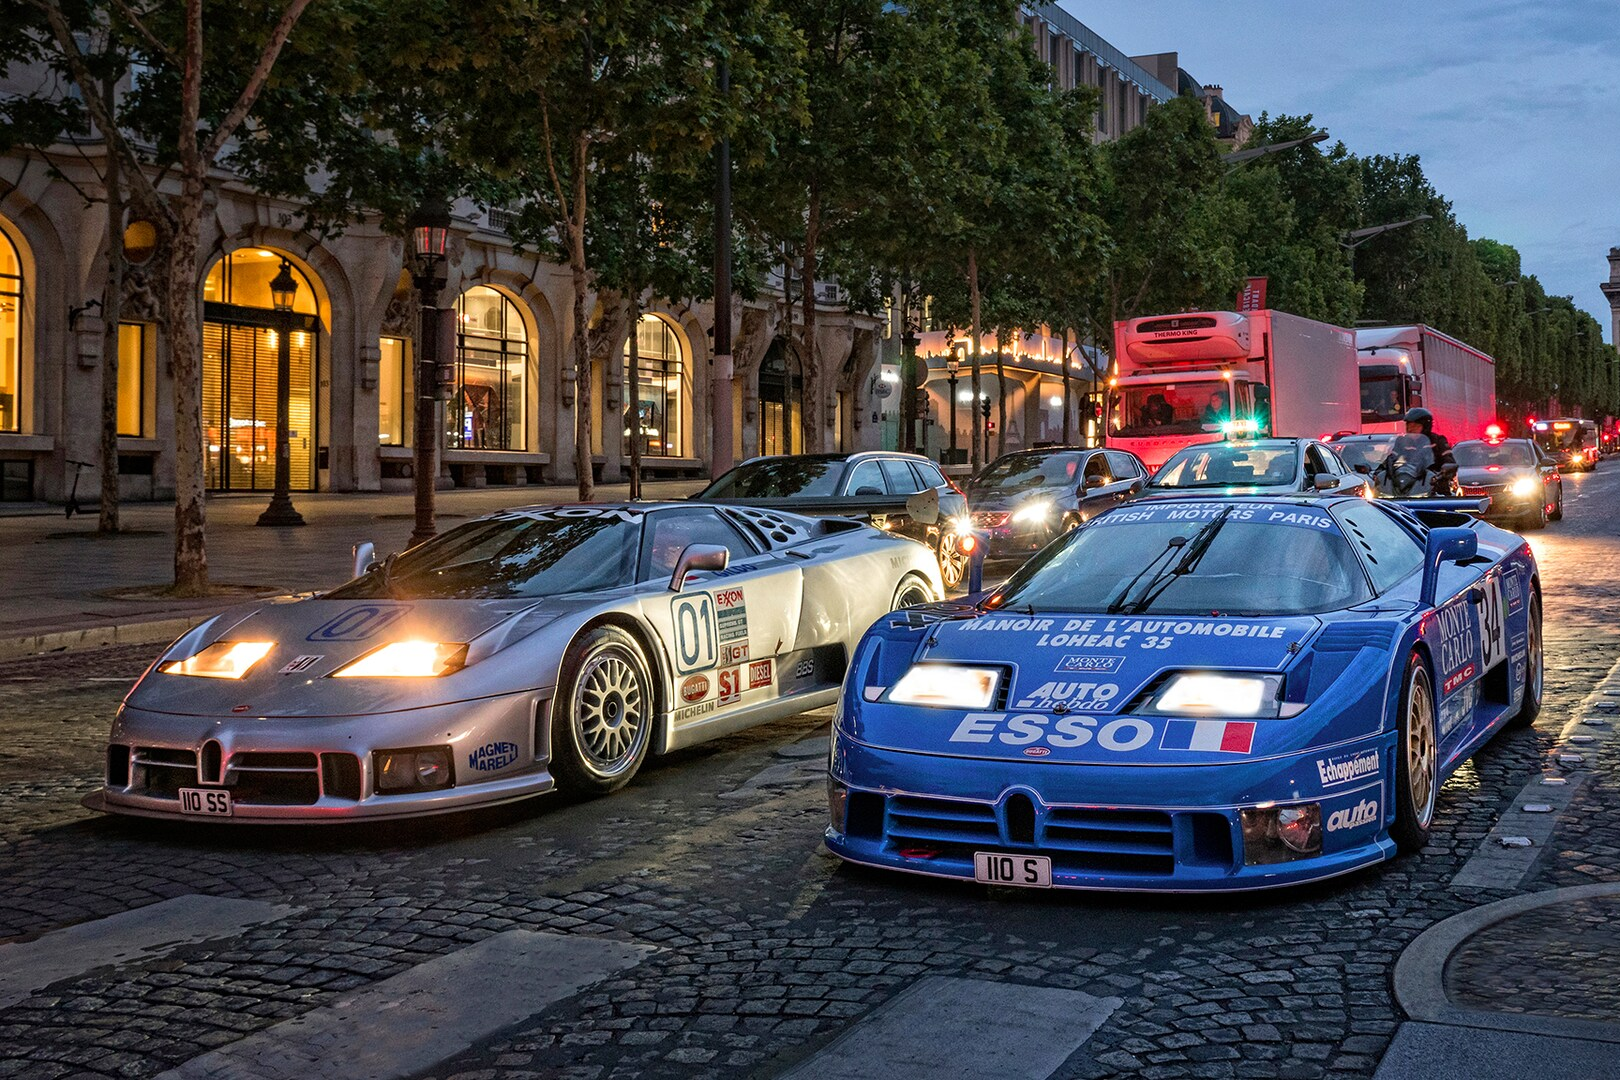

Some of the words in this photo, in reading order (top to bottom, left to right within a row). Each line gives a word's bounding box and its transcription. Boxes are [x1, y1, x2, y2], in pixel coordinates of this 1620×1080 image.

[1268, 511, 1332, 529] PARIS
[716, 589, 743, 607] EXXON
[321, 607, 405, 638] 01
[678, 599, 713, 666] 01
[958, 618, 1055, 632] MANOIR
[1062, 619, 1097, 632] DE
[1103, 619, 1288, 639] L'AUTOMOBILE
[1436, 600, 1472, 644] MONTE
[1480, 582, 1501, 667] 34
[1036, 633, 1132, 648] LOHEAC
[1140, 635, 1175, 649] 35
[732, 645, 748, 660] GT
[1068, 656, 1117, 664] MONTE
[1441, 630, 1474, 676] CARLO
[750, 663, 771, 682] DIESEL
[796, 659, 814, 678] BBS
[1065, 661, 1114, 669] CARLO
[682, 680, 708, 697] BUGATTI
[719, 669, 741, 702] S1
[1444, 666, 1473, 691] TMC
[1026, 681, 1120, 702] AUTO
[674, 701, 715, 723] MICHELIN
[948, 713, 1155, 752] ESSO
[182, 791, 201, 811] 110
[206, 793, 228, 813] SS
[1326, 798, 1378, 832] auto
[986, 856, 1014, 882] 110
[1023, 859, 1038, 883] S
